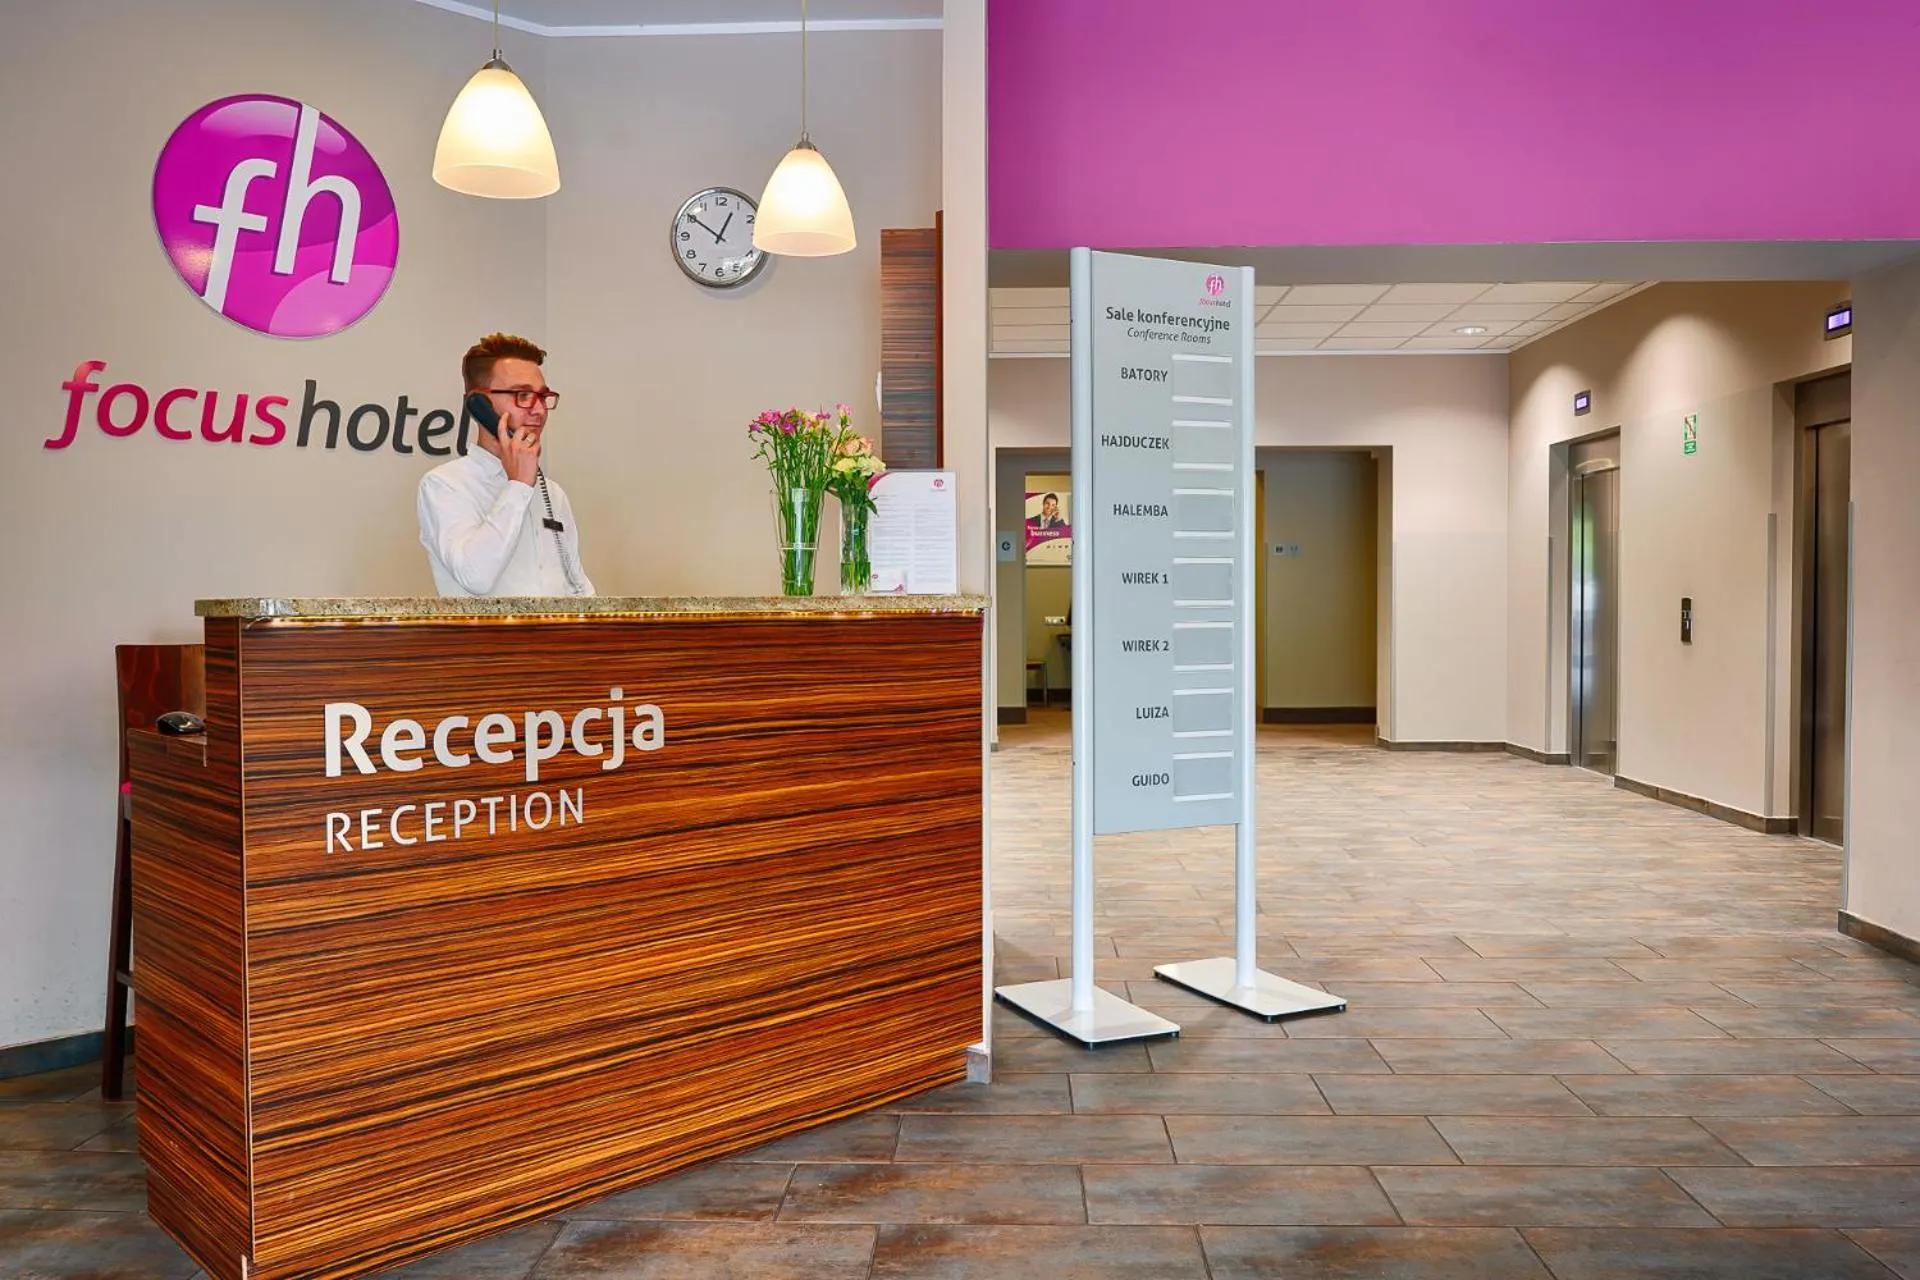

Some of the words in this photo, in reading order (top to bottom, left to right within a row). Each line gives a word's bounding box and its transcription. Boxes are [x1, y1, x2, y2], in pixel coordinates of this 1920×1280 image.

[193, 101, 362, 314] fh
[715, 196, 728, 207] 12
[680, 231, 691, 241] 9
[685, 249, 697, 259] 8
[698, 262, 707, 272] 7
[715, 267, 725, 277] 6
[1105, 306, 1134, 322] Sale
[1137, 308, 1231, 333] konferencyjne
[1127, 326, 1180, 341] Conference
[1180, 331, 1212, 345] Rooms
[1120, 366, 1169, 383] BATORY
[1101, 433, 1170, 451] HAJDUCZEK
[1113, 503, 1169, 518] HALEMBA
[1121, 571, 1160, 585] WIREK
[1162, 573, 1170, 585] 1
[1122, 639, 1161, 652] WIREK
[1162, 640, 1171, 652] 2
[1135, 705, 1170, 720] LUIZA
[323, 686, 666, 783] Recepcja
[1131, 772, 1170, 788] GUIDO
[325, 787, 584, 855] RECEPTION
